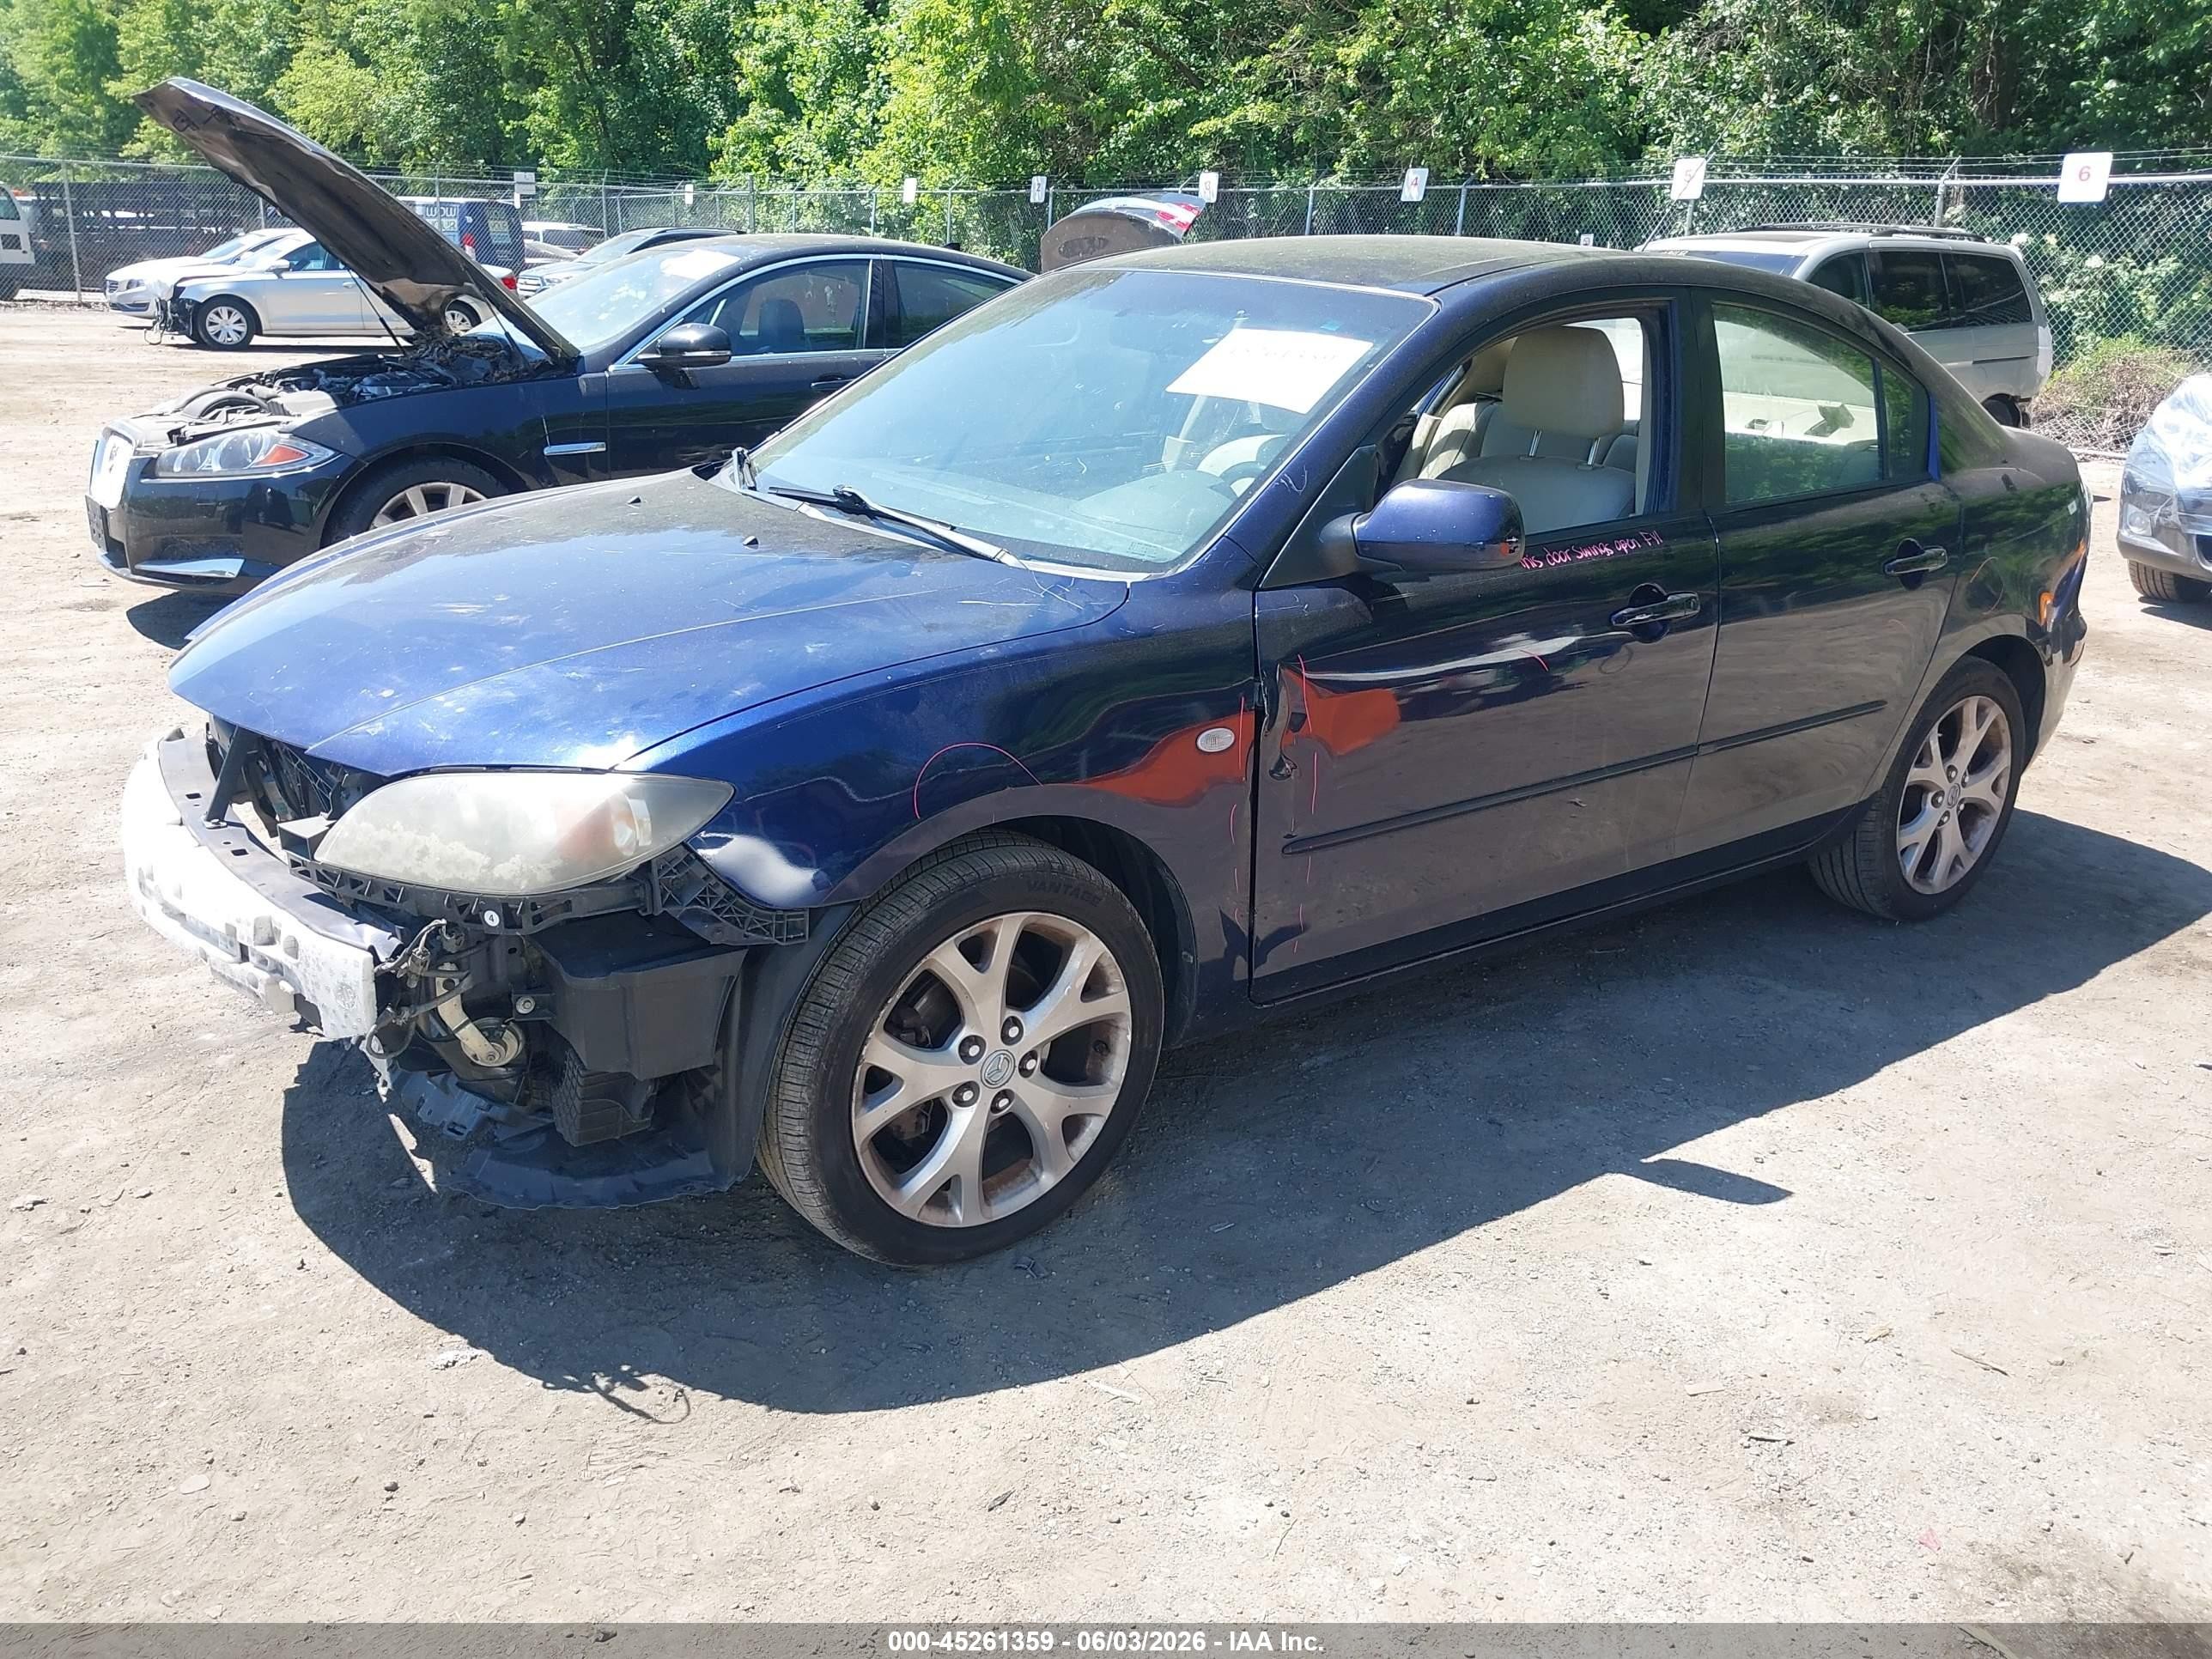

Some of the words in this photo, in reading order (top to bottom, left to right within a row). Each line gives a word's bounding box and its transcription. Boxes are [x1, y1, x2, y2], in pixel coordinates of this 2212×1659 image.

[1411, 177, 1419, 187] 4
[2079, 166, 2091, 182] 6
[1544, 547, 1572, 567] door
[1613, 538, 1641, 555] open
[1639, 530, 1664, 547] FYI
[1028, 879, 1103, 907] VANTAGE
[489, 915, 495, 923] 4
